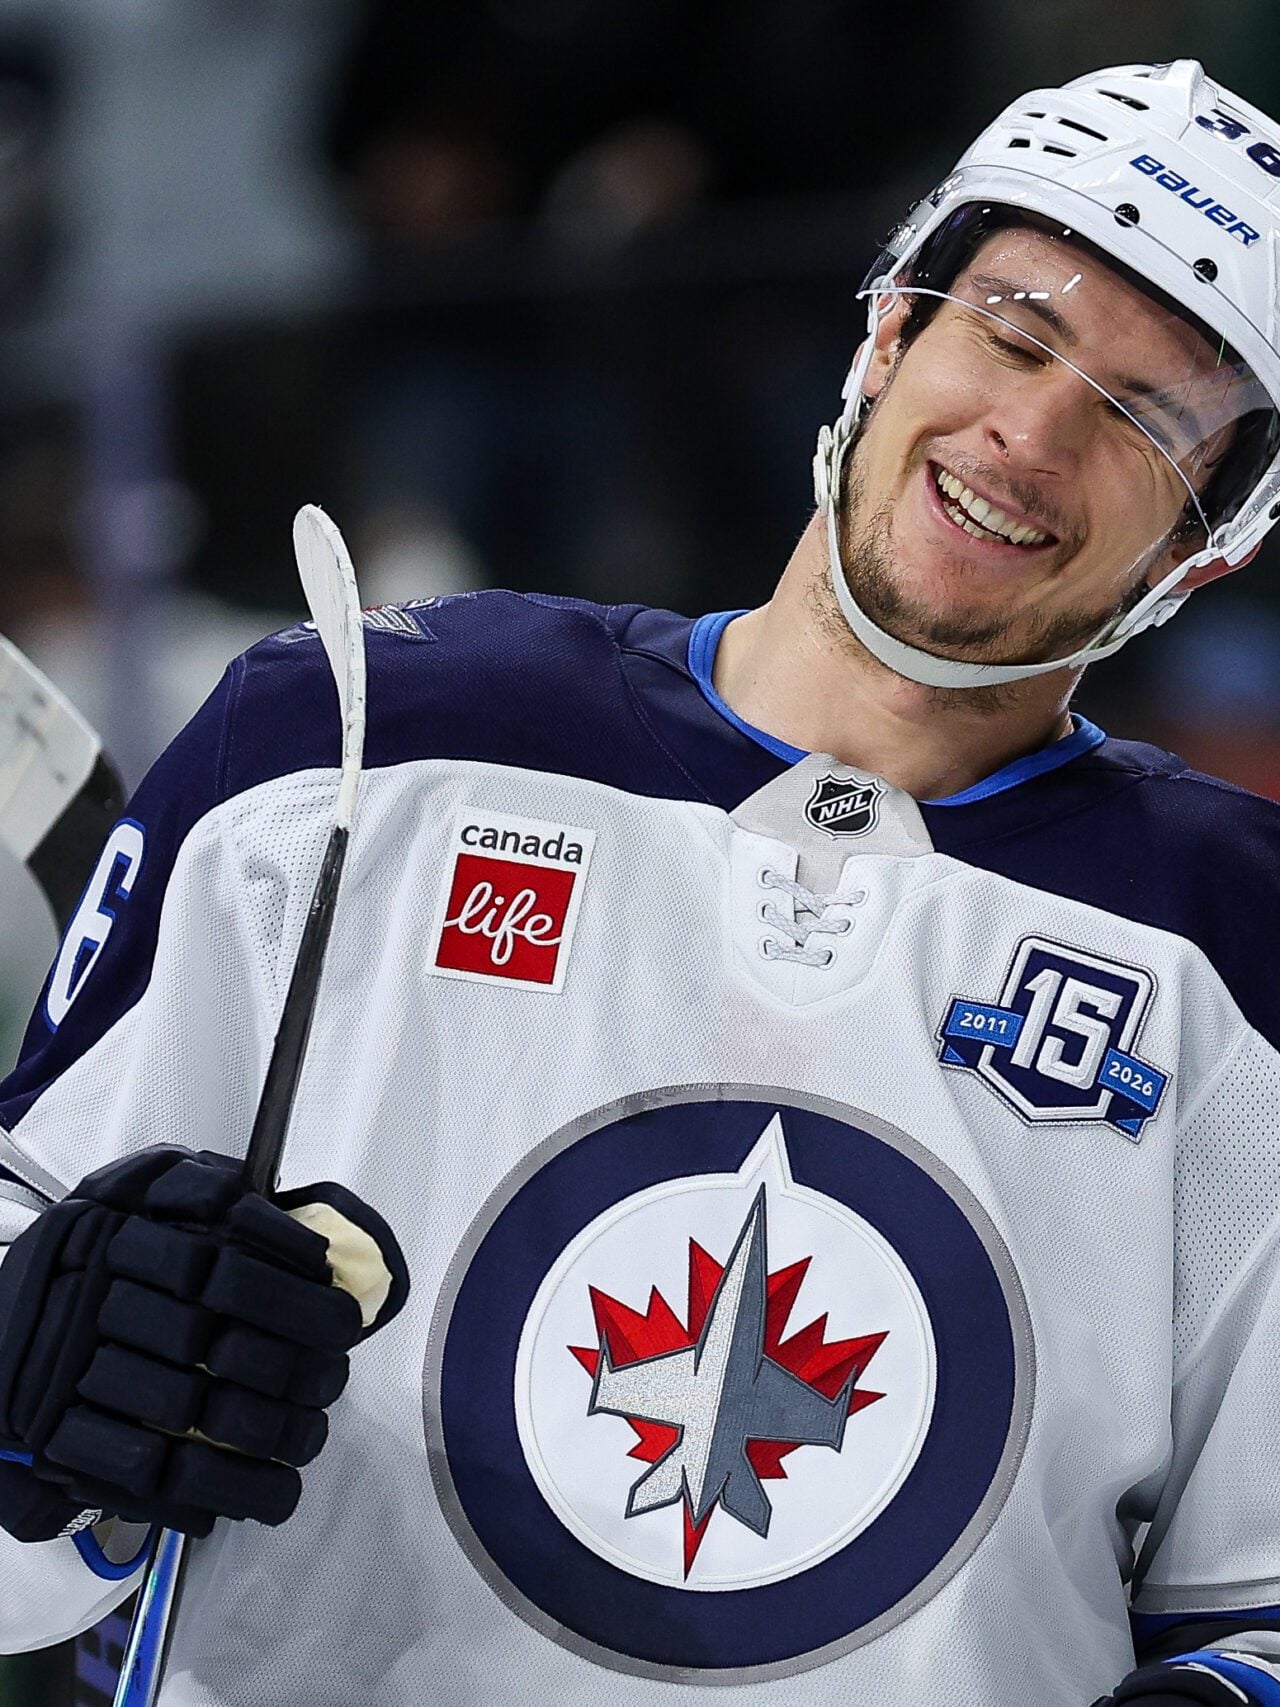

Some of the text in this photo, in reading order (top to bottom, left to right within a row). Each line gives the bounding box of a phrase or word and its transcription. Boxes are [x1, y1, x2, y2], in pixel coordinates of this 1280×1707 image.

[818, 793, 869, 822] NHL
[460, 824, 584, 865] canada
[443, 880, 562, 966] life
[959, 1011, 1009, 1034] 2011
[1010, 967, 1125, 1091] 15
[1107, 1060, 1154, 1097] 2026
